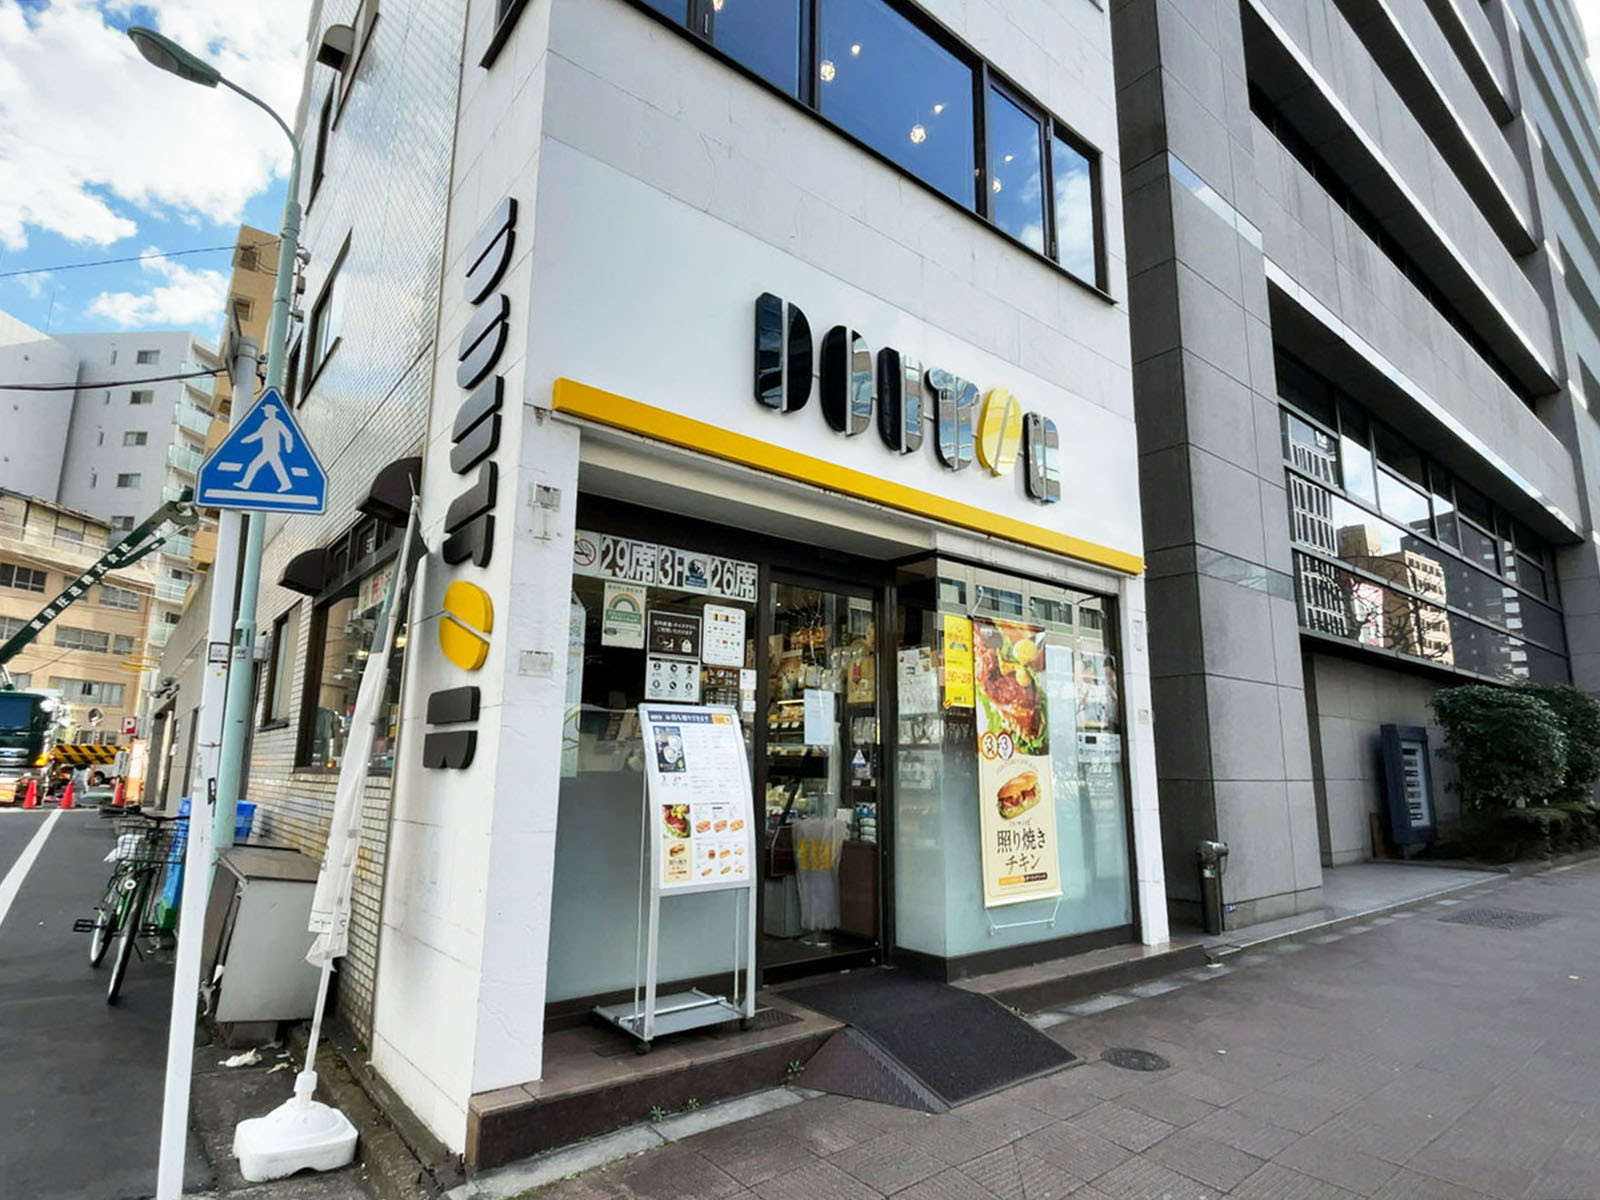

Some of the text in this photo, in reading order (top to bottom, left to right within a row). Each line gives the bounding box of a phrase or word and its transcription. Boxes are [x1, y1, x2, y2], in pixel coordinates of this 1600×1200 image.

[754, 291, 1062, 504] DOUTOR
[601, 538, 657, 586] 29席
[711, 558, 757, 601] 26席
[123, 717, 135, 733] P
[997, 827, 1046, 854] 照り焼き
[1005, 852, 1041, 875] チキン
